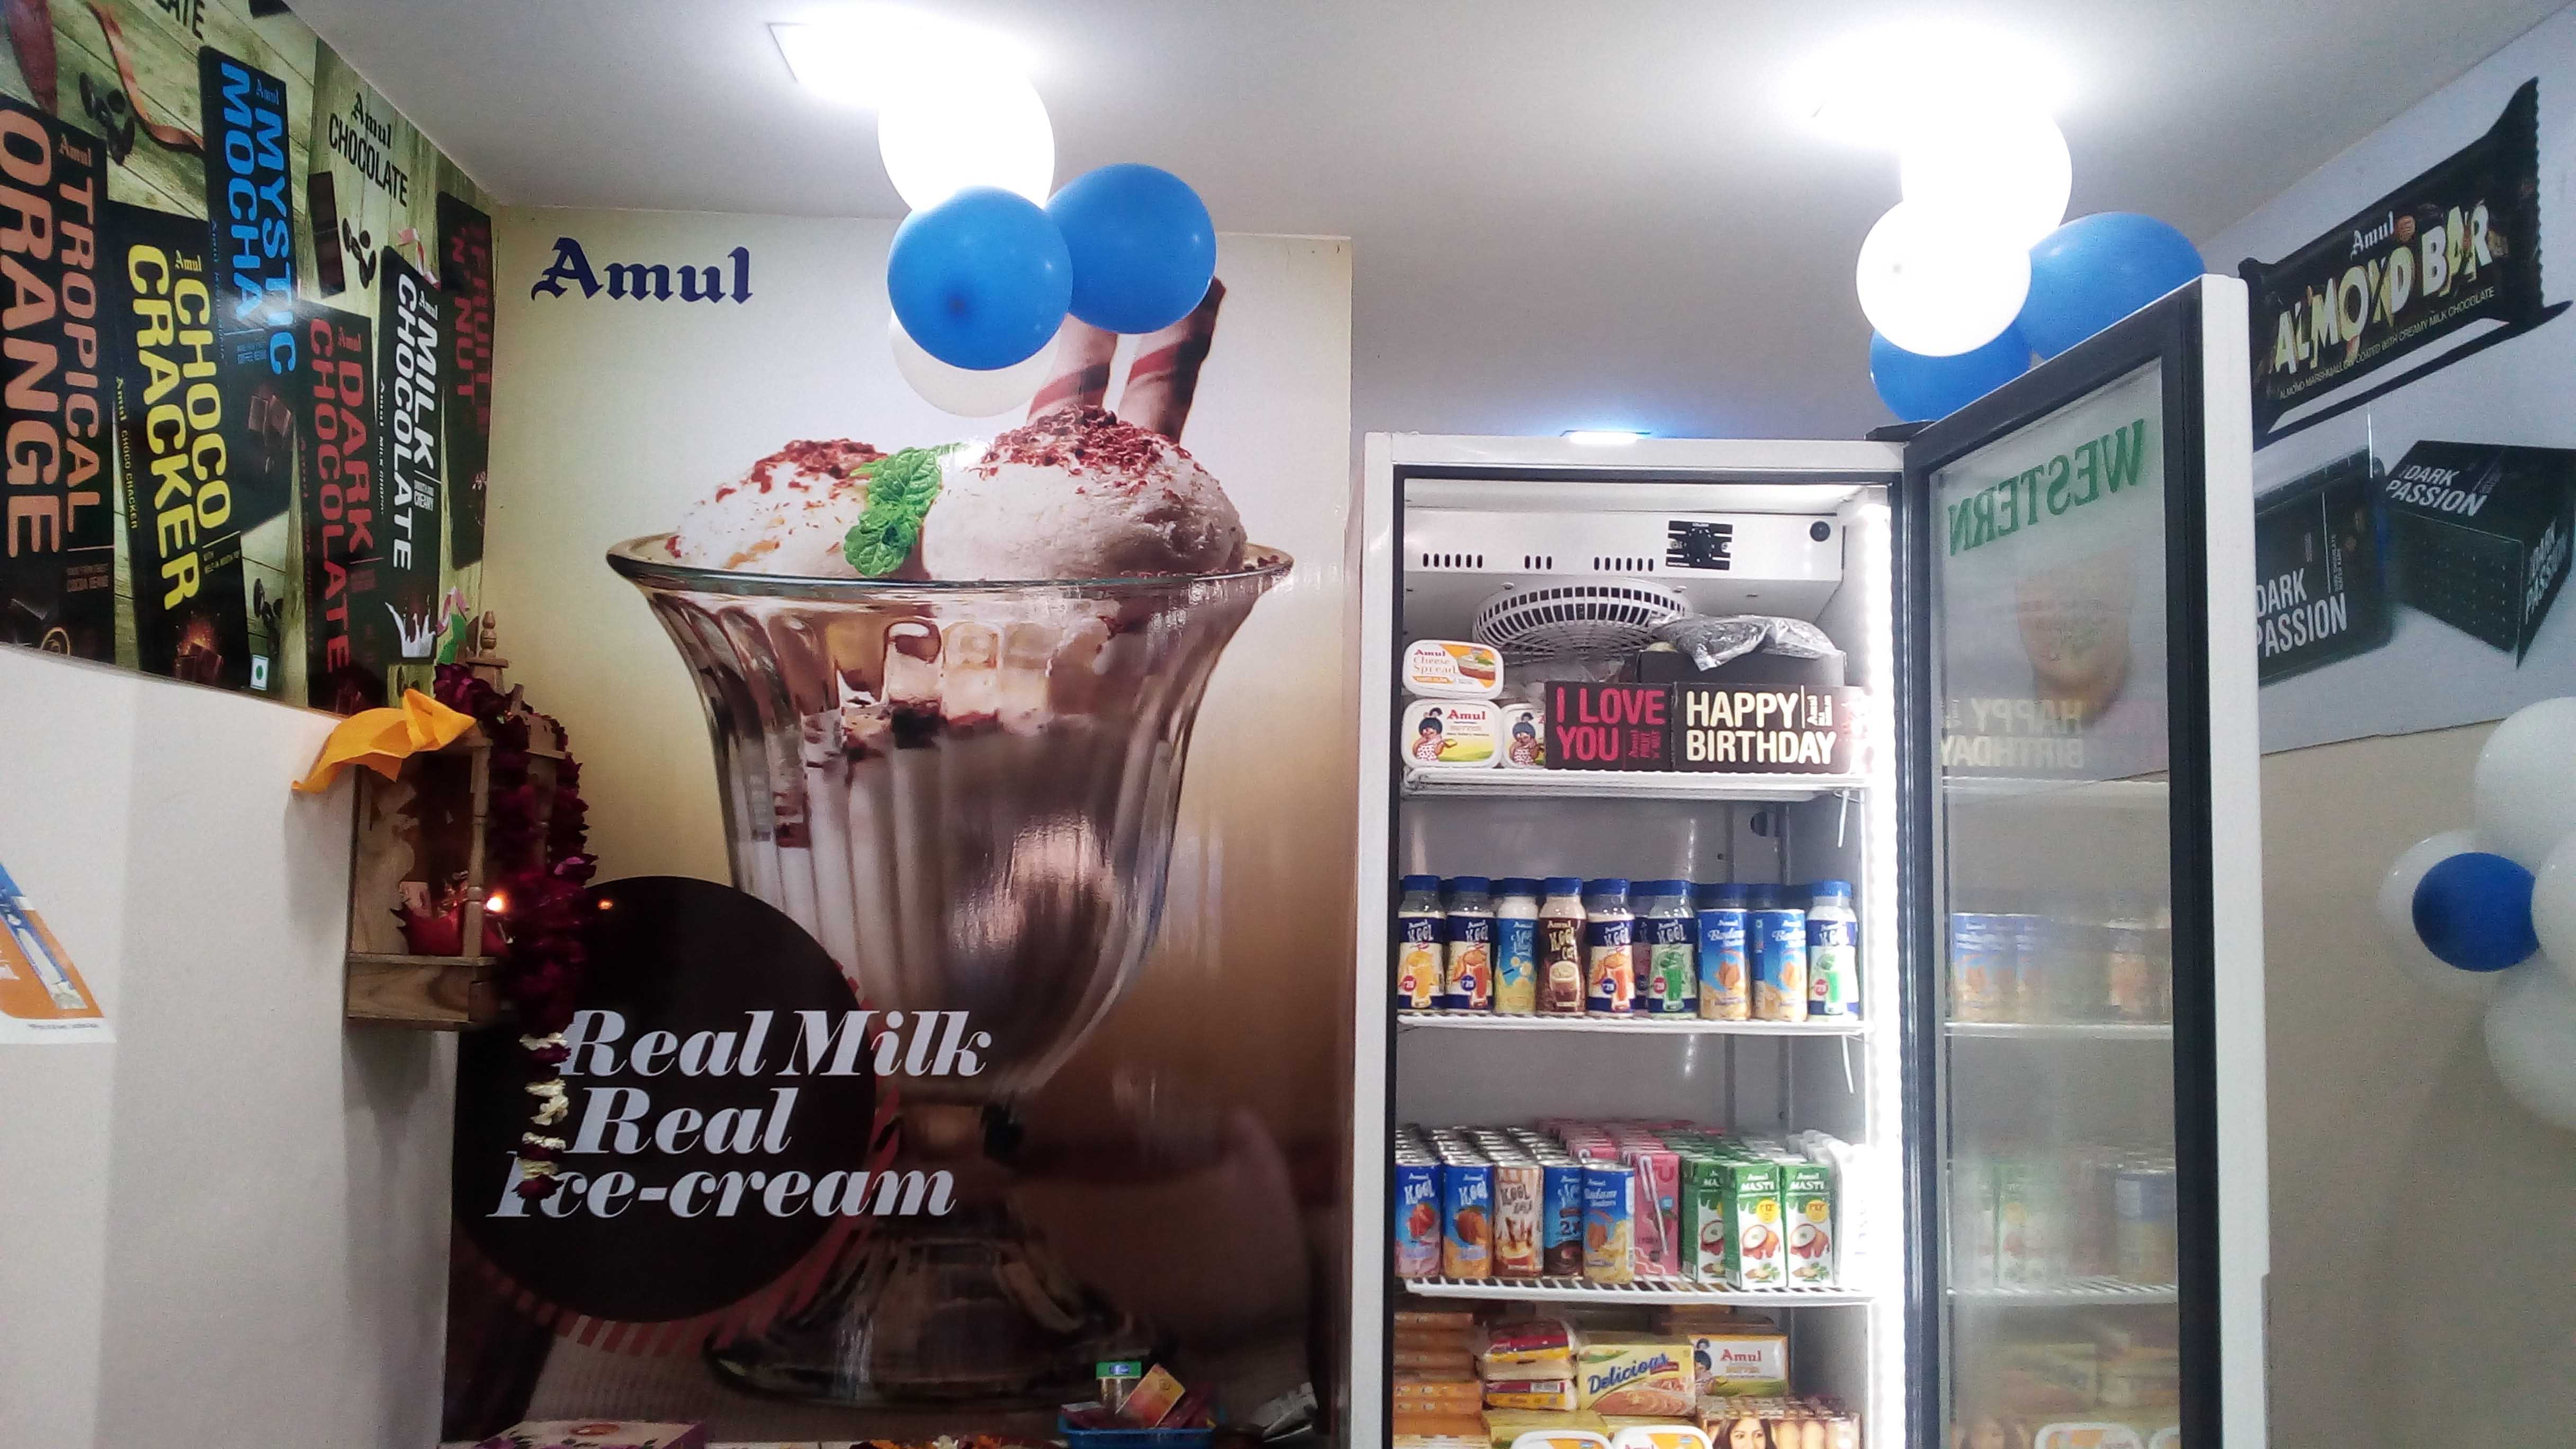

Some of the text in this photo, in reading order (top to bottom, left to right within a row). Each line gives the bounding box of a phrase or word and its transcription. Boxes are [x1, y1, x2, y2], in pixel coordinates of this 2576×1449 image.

[350, 92, 392, 150] Amul
[328, 112, 408, 207] CHOCOLATE
[221, 61, 263, 328] MOCHA
[175, 249, 202, 272] Amul
[254, 108, 296, 375] MYSTIC
[2351, 211, 2394, 260] Amul
[531, 237, 753, 305] Amul
[2269, 198, 2492, 375] ALMOND BAR
[0, 109, 61, 558] ORANGE
[59, 176, 100, 532] TROPICAL
[174, 278, 231, 529] CHOCO
[392, 274, 418, 571] CHOCOLATE
[414, 316, 439, 471] MILK
[128, 244, 200, 610] CRACKER
[339, 361, 374, 553] DARK
[2404, 465, 2461, 486] DARK
[309, 318, 350, 674] CHOCOLATE
[2385, 479, 2488, 516] PASSION
[2256, 568, 2307, 619] DARK
[1413, 656, 1450, 665] Cheese
[1413, 664, 1457, 675] Spread
[1446, 710, 1486, 721] Amul
[1556, 688, 1666, 725] I LOVE
[1686, 691, 1799, 729] HAPPY
[1557, 726, 1620, 762] YOU
[1686, 729, 1837, 764] BIRTHDAY
[553, 1009, 992, 1078] Real Milk
[566, 1086, 799, 1156] Real
[486, 1151, 956, 1218] Ice-cream
[1740, 1181, 1775, 1191] MASTI
[1789, 1180, 1826, 1191] MASTI
[1588, 1353, 1670, 1394] Delicious
[1720, 1348, 1763, 1362] Amul
